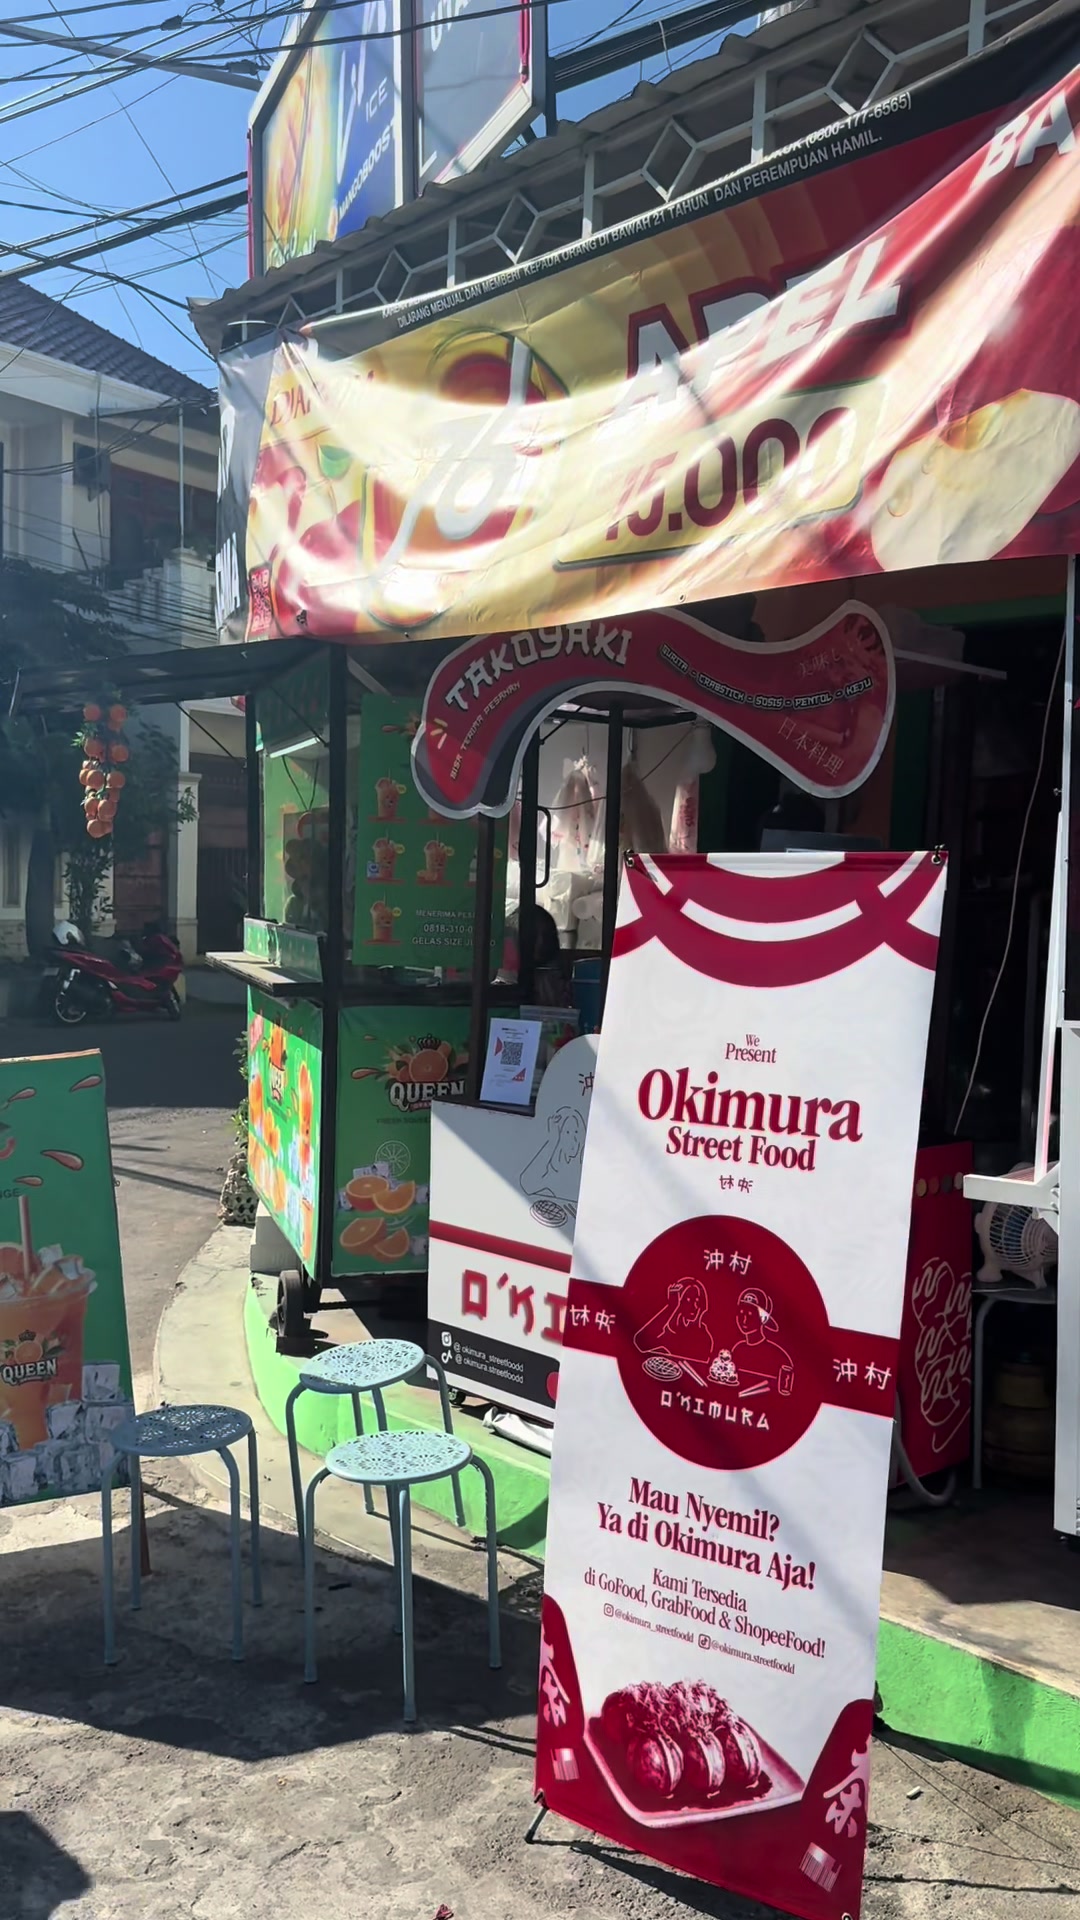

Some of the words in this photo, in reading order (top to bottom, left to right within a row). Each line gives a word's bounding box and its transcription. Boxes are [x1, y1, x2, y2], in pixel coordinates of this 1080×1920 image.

[366, 76, 389, 123] ICE
[397, 305, 432, 328] DILARANG
[431, 294, 465, 315] MENJUAL
[464, 285, 482, 301] DAN
[483, 271, 521, 293] MEMBERI
[523, 254, 561, 276] KEPADA
[561, 239, 597, 261] ORANG
[599, 235, 610, 246] DI
[611, 216, 652, 241] BAWAH
[652, 210, 666, 226] 21
[667, 192, 709, 220] TAHUN
[714, 180, 741, 202] DAN
[743, 148, 829, 191] PEREMPUAN
[831, 128, 883, 159] HAMIL.
[603, 236, 901, 428] APEL
[605, 406, 858, 541] 15.000
[445, 621, 633, 710] TAKOYAKI
[698, 674, 746, 702] CRABSTICK
[755, 695, 783, 708] SOSIS
[794, 695, 833, 709] PENTOL
[845, 678, 873, 697] KEJU
[451, 754, 463, 780] BISA
[461, 714, 484, 751] TERIMA
[484, 681, 521, 716] PESANAN
[777, 716, 846, 779] 日本料理
[412, 936, 442, 946] GELAS
[445, 937, 463, 946] SIZE
[415, 909, 457, 919] MENERIMA
[724, 1042, 777, 1063] Present
[746, 1034, 761, 1047] We
[390, 1080, 465, 1111] QUEEN
[638, 1067, 863, 1142] Okimura
[666, 1125, 744, 1163] Street
[748, 1135, 817, 1172] Food
[3, 1358, 57, 1385] QUEEN
[660, 1390, 770, 1431] O'KIMURA
[628, 1476, 680, 1515] Mau
[685, 1491, 780, 1542] Nyemil?
[597, 1502, 622, 1534] Ya
[627, 1511, 648, 1543] di
[654, 1520, 761, 1575] Okimura
[766, 1551, 816, 1590] Aja!
[584, 1567, 596, 1586] di
[598, 1572, 649, 1608] GoFood,
[651, 1590, 716, 1625] GrabFood
[718, 1611, 732, 1631] &
[734, 1615, 826, 1659] ShopeeFood!
[652, 1568, 688, 1593] Kami
[692, 1578, 748, 1613] Tersedia
[614, 1608, 695, 1643] @okimura_streetfoodd
[710, 1639, 796, 1675] @okimura.streetfoodd
